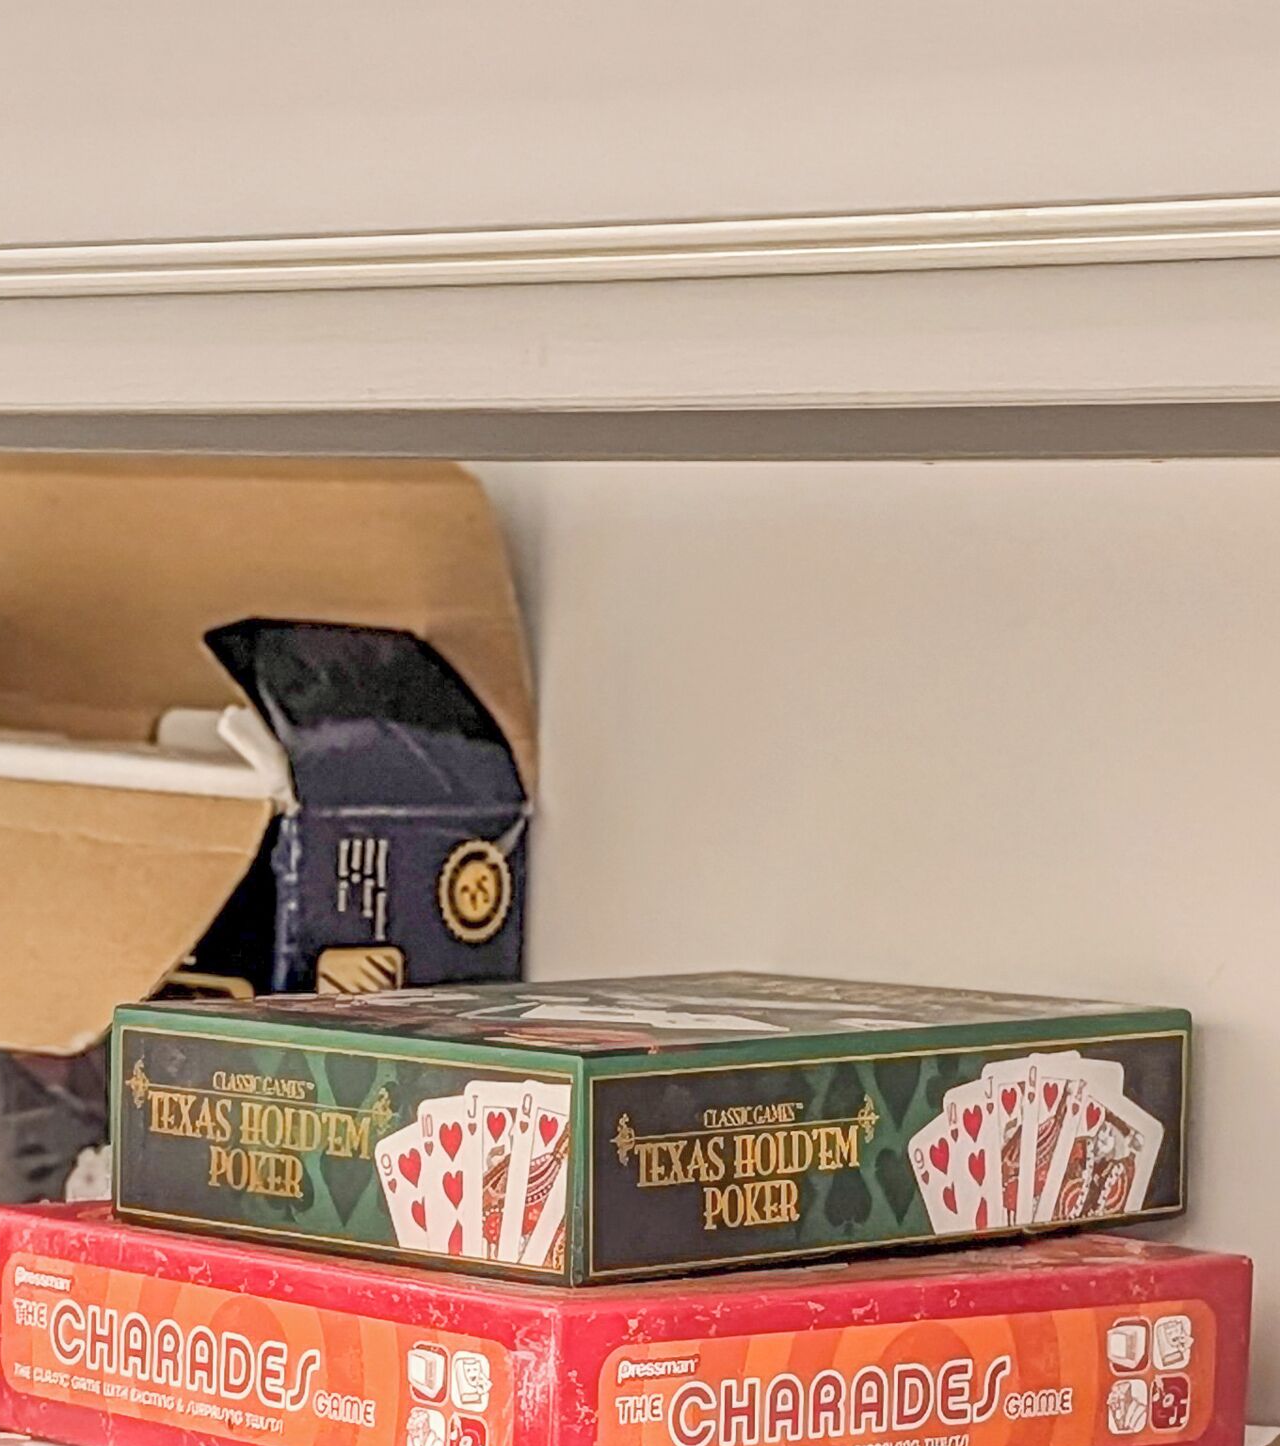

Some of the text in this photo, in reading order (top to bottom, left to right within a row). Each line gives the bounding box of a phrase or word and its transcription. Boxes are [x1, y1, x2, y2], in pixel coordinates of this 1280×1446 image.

[212, 1071, 261, 1096] CLASSIC
[984, 1076, 994, 1099] J
[467, 1095, 479, 1120] J
[521, 1093, 533, 1117] Q
[703, 1106, 753, 1129] CLASSIC
[147, 1090, 372, 1160] TEXAS HOLD'EM
[421, 1113, 435, 1138] 10
[381, 1157, 395, 1177] 9
[634, 1126, 862, 1188] TEXAS HOLD'EM
[914, 1148, 925, 1170] 9
[208, 1146, 305, 1199] POKER
[701, 1179, 802, 1231] POKER
[13, 1298, 377, 1428] THE CHARADES GAME
[615, 1393, 663, 1425] THE
[1003, 1387, 1073, 1422] GAME
